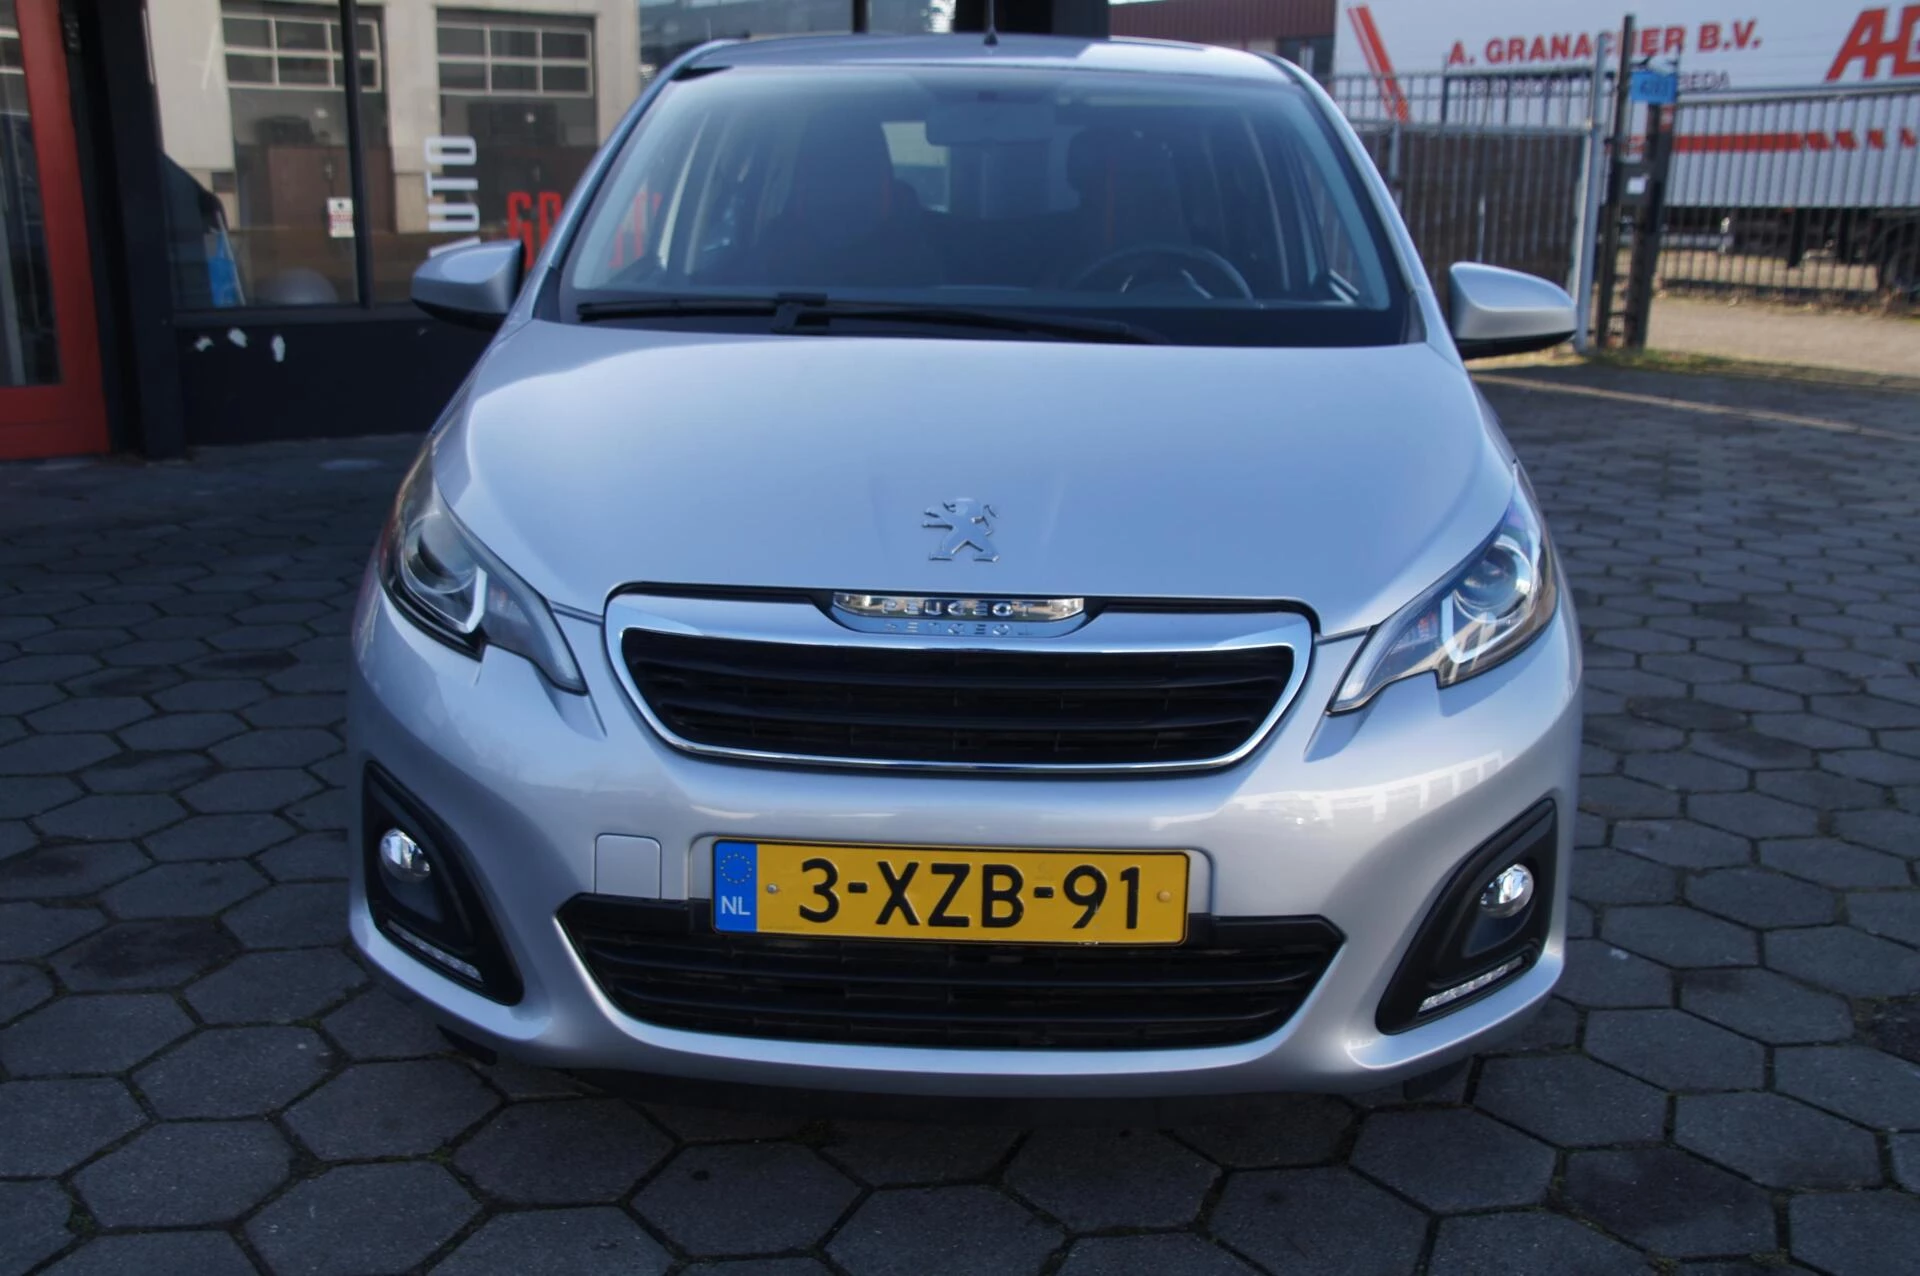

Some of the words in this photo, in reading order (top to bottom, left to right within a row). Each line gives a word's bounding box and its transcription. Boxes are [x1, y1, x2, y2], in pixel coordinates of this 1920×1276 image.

[1448, 40, 1475, 65] A.
[1698, 18, 1763, 52] B.V.
[720, 895, 751, 916] NL
[798, 857, 1141, 930] 3-XZB-91
